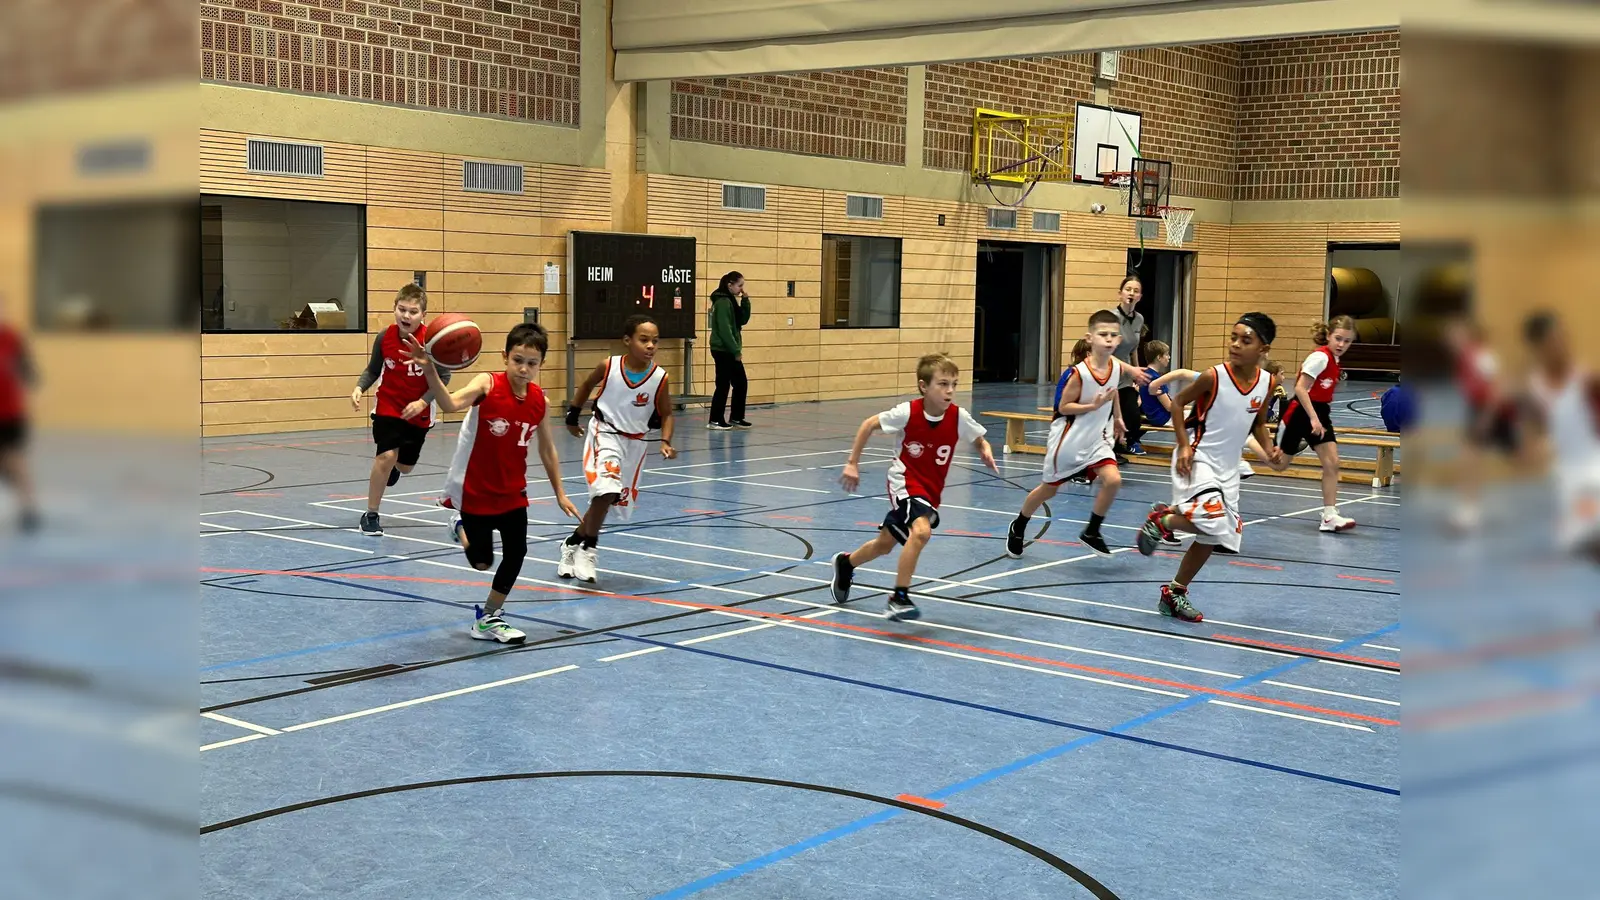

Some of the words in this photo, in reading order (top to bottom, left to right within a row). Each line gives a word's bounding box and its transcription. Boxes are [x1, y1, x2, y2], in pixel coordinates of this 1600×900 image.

[588, 267, 613, 281] HEIM
[662, 266, 691, 283] GÄSTE
[935, 445, 951, 466] 9
